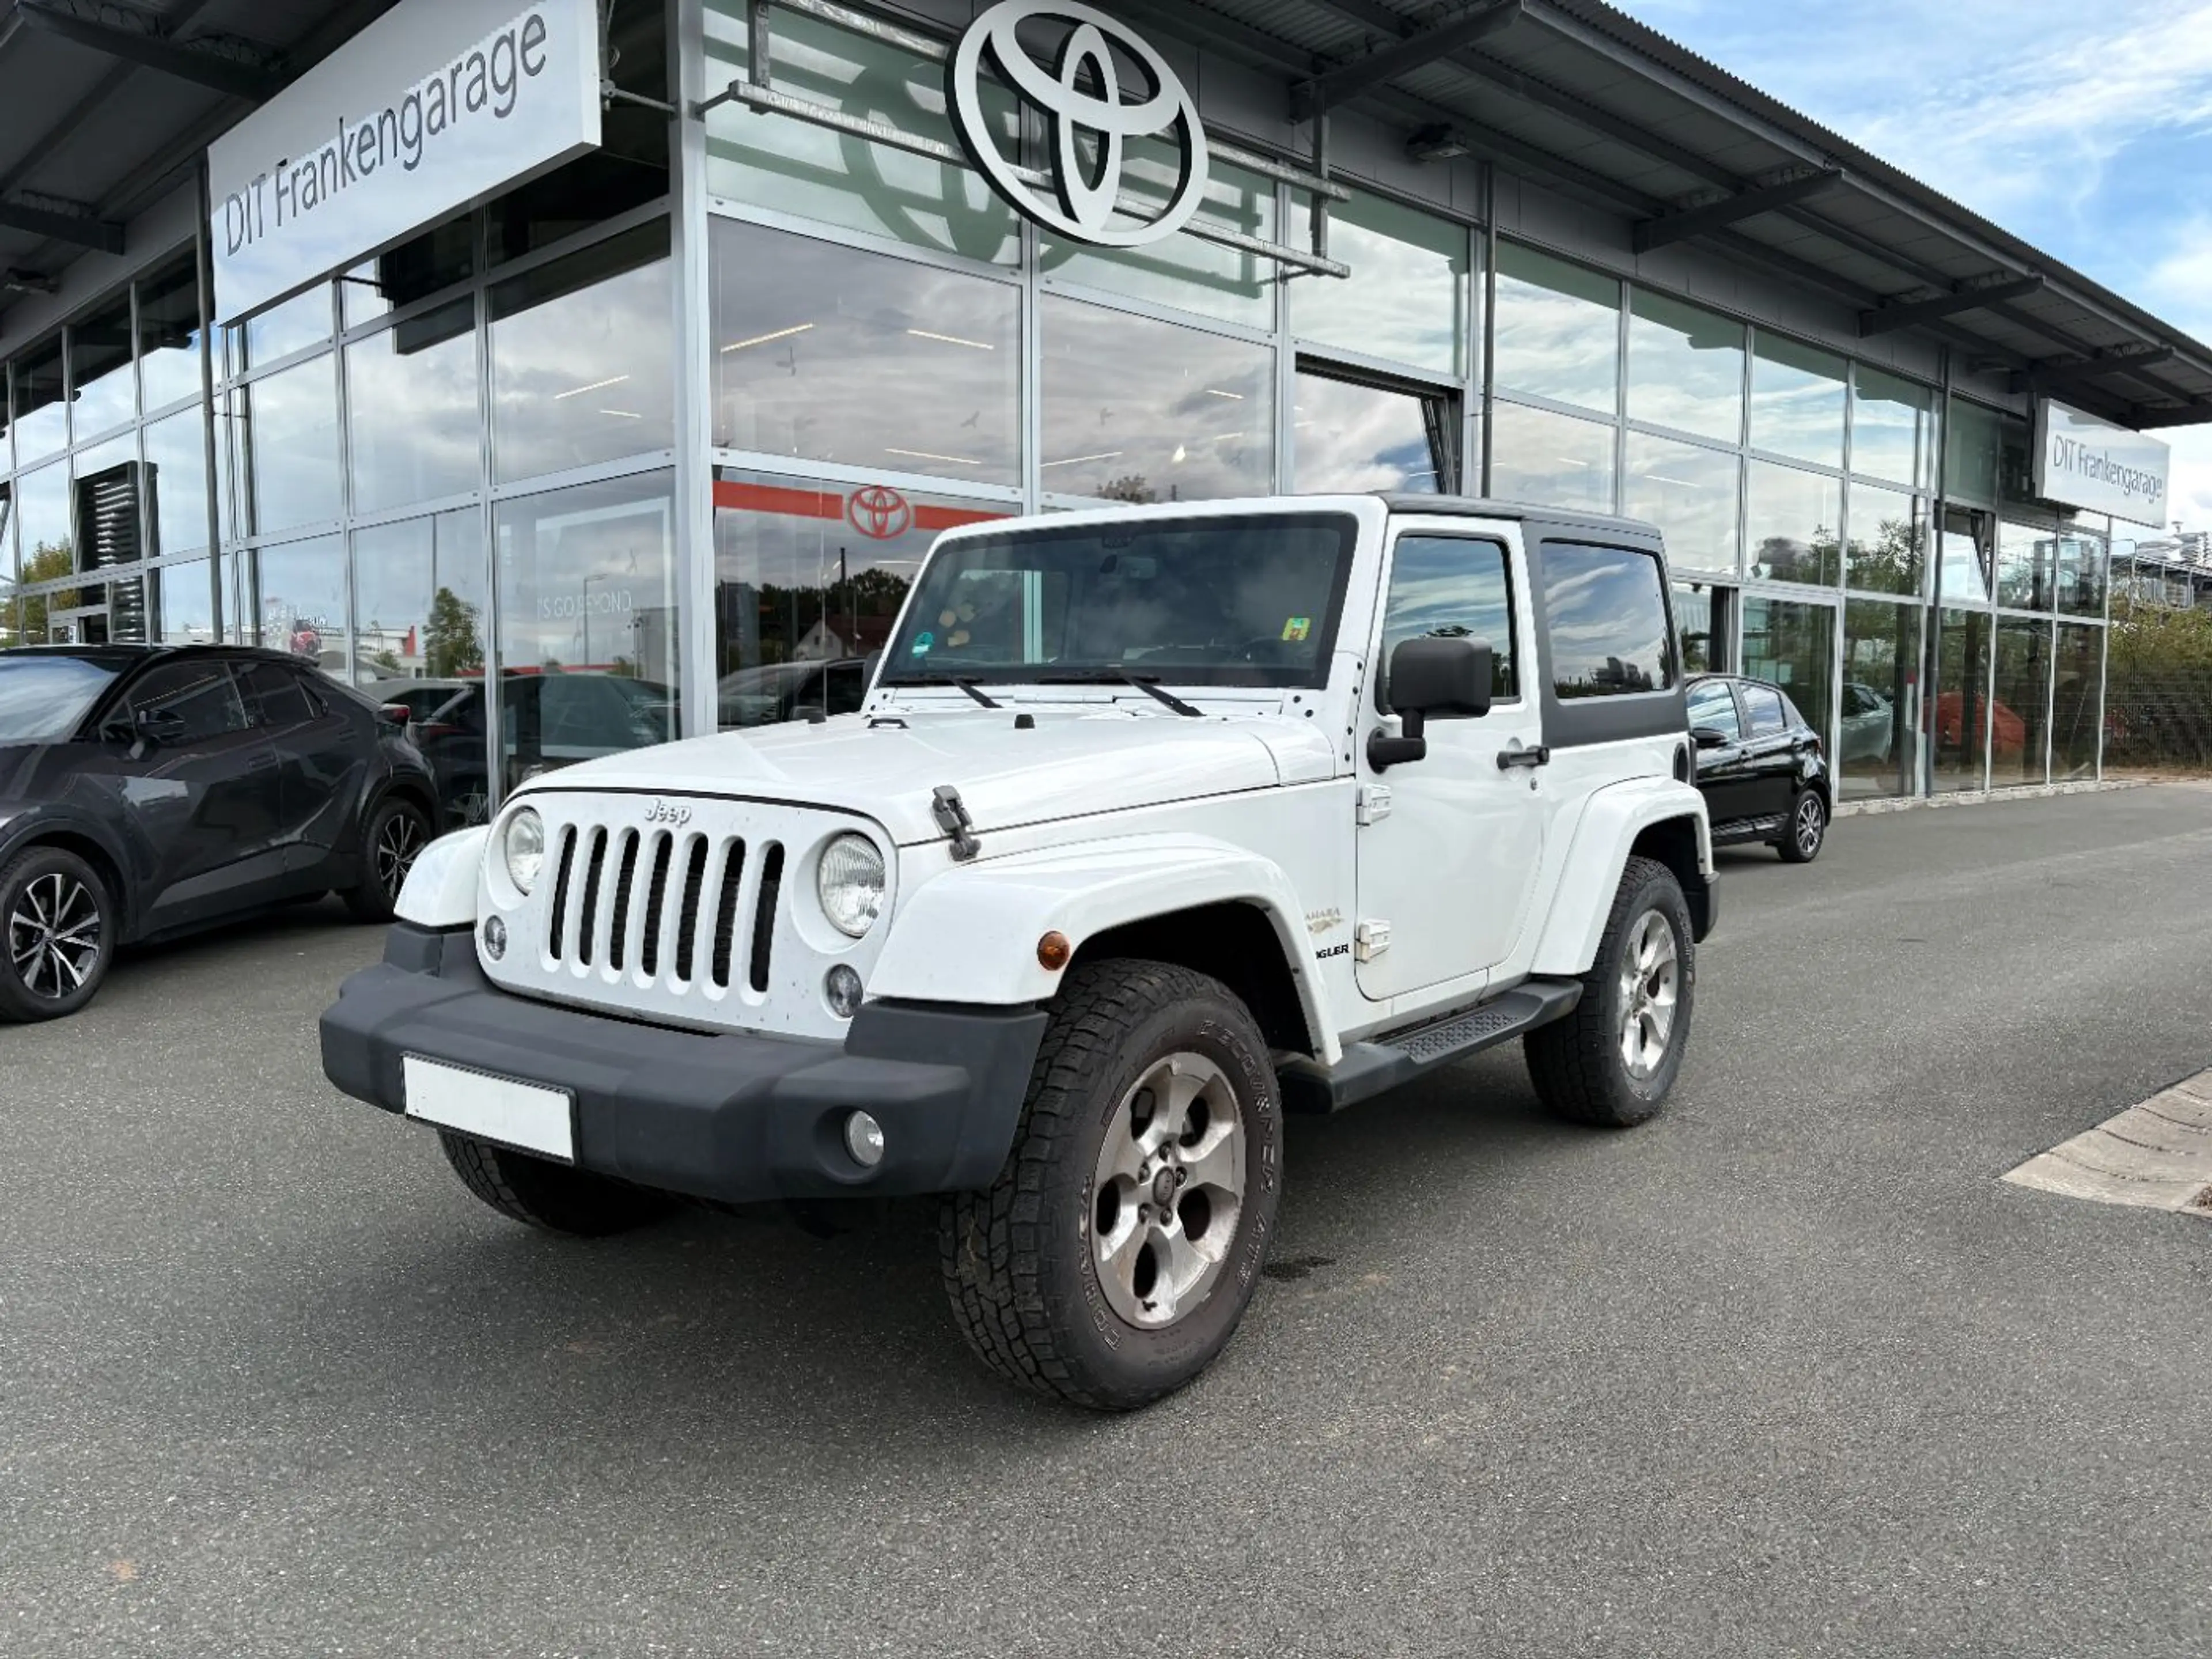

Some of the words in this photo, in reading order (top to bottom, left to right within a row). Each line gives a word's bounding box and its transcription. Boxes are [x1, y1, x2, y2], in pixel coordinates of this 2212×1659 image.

[226, 173, 267, 257] DIT
[275, 13, 547, 227] Frankengarage
[2053, 434, 2076, 472] DIT
[2078, 443, 2163, 504] Frankengarage
[554, 596, 574, 619] GO
[645, 797, 692, 829] Jeep
